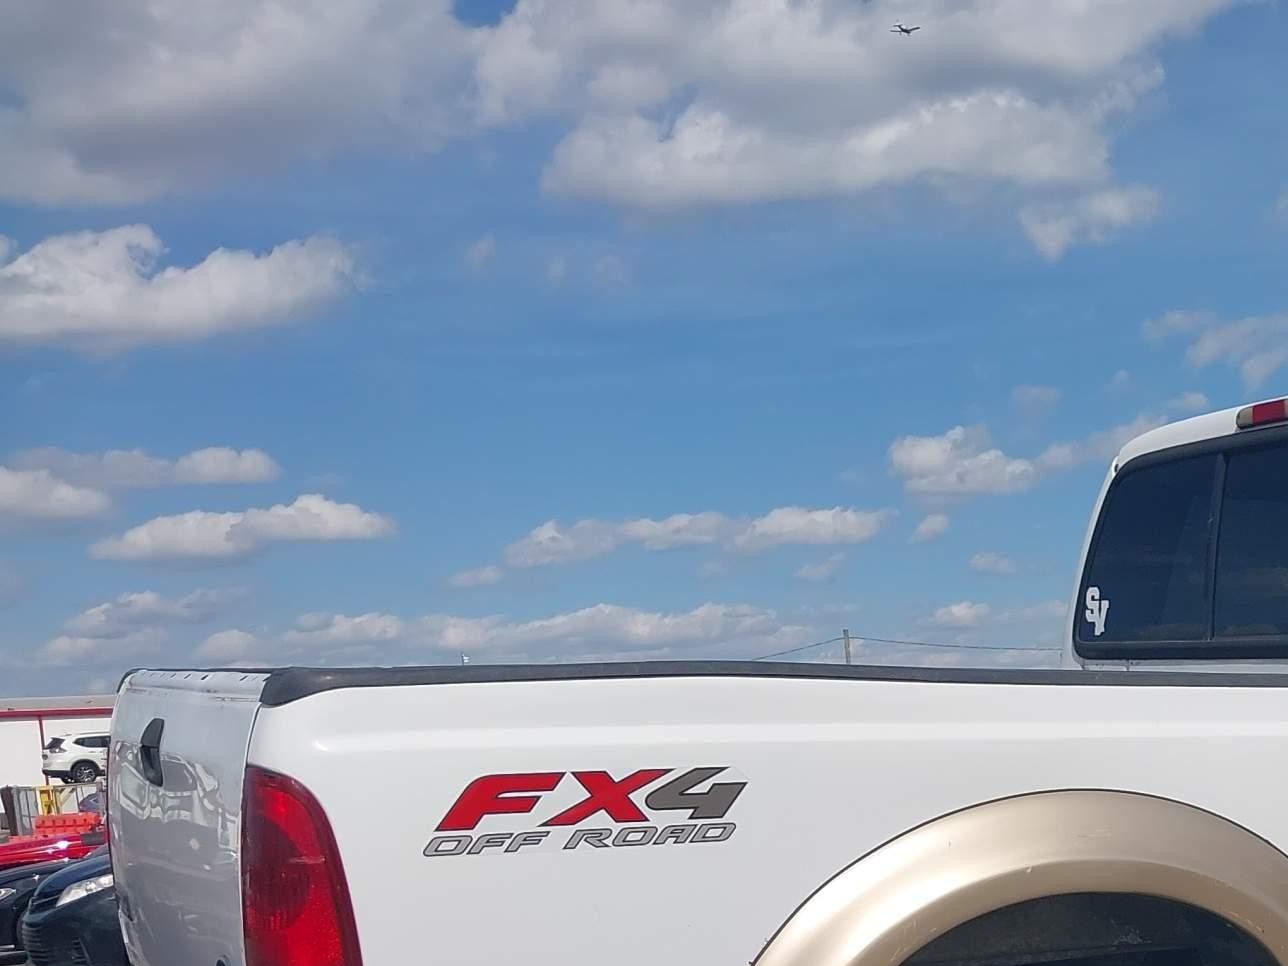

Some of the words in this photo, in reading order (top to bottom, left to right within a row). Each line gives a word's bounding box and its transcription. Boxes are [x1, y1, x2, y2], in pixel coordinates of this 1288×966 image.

[434, 766, 748, 832] FX4
[422, 831, 551, 857] OFF
[562, 822, 737, 850] ROAD
